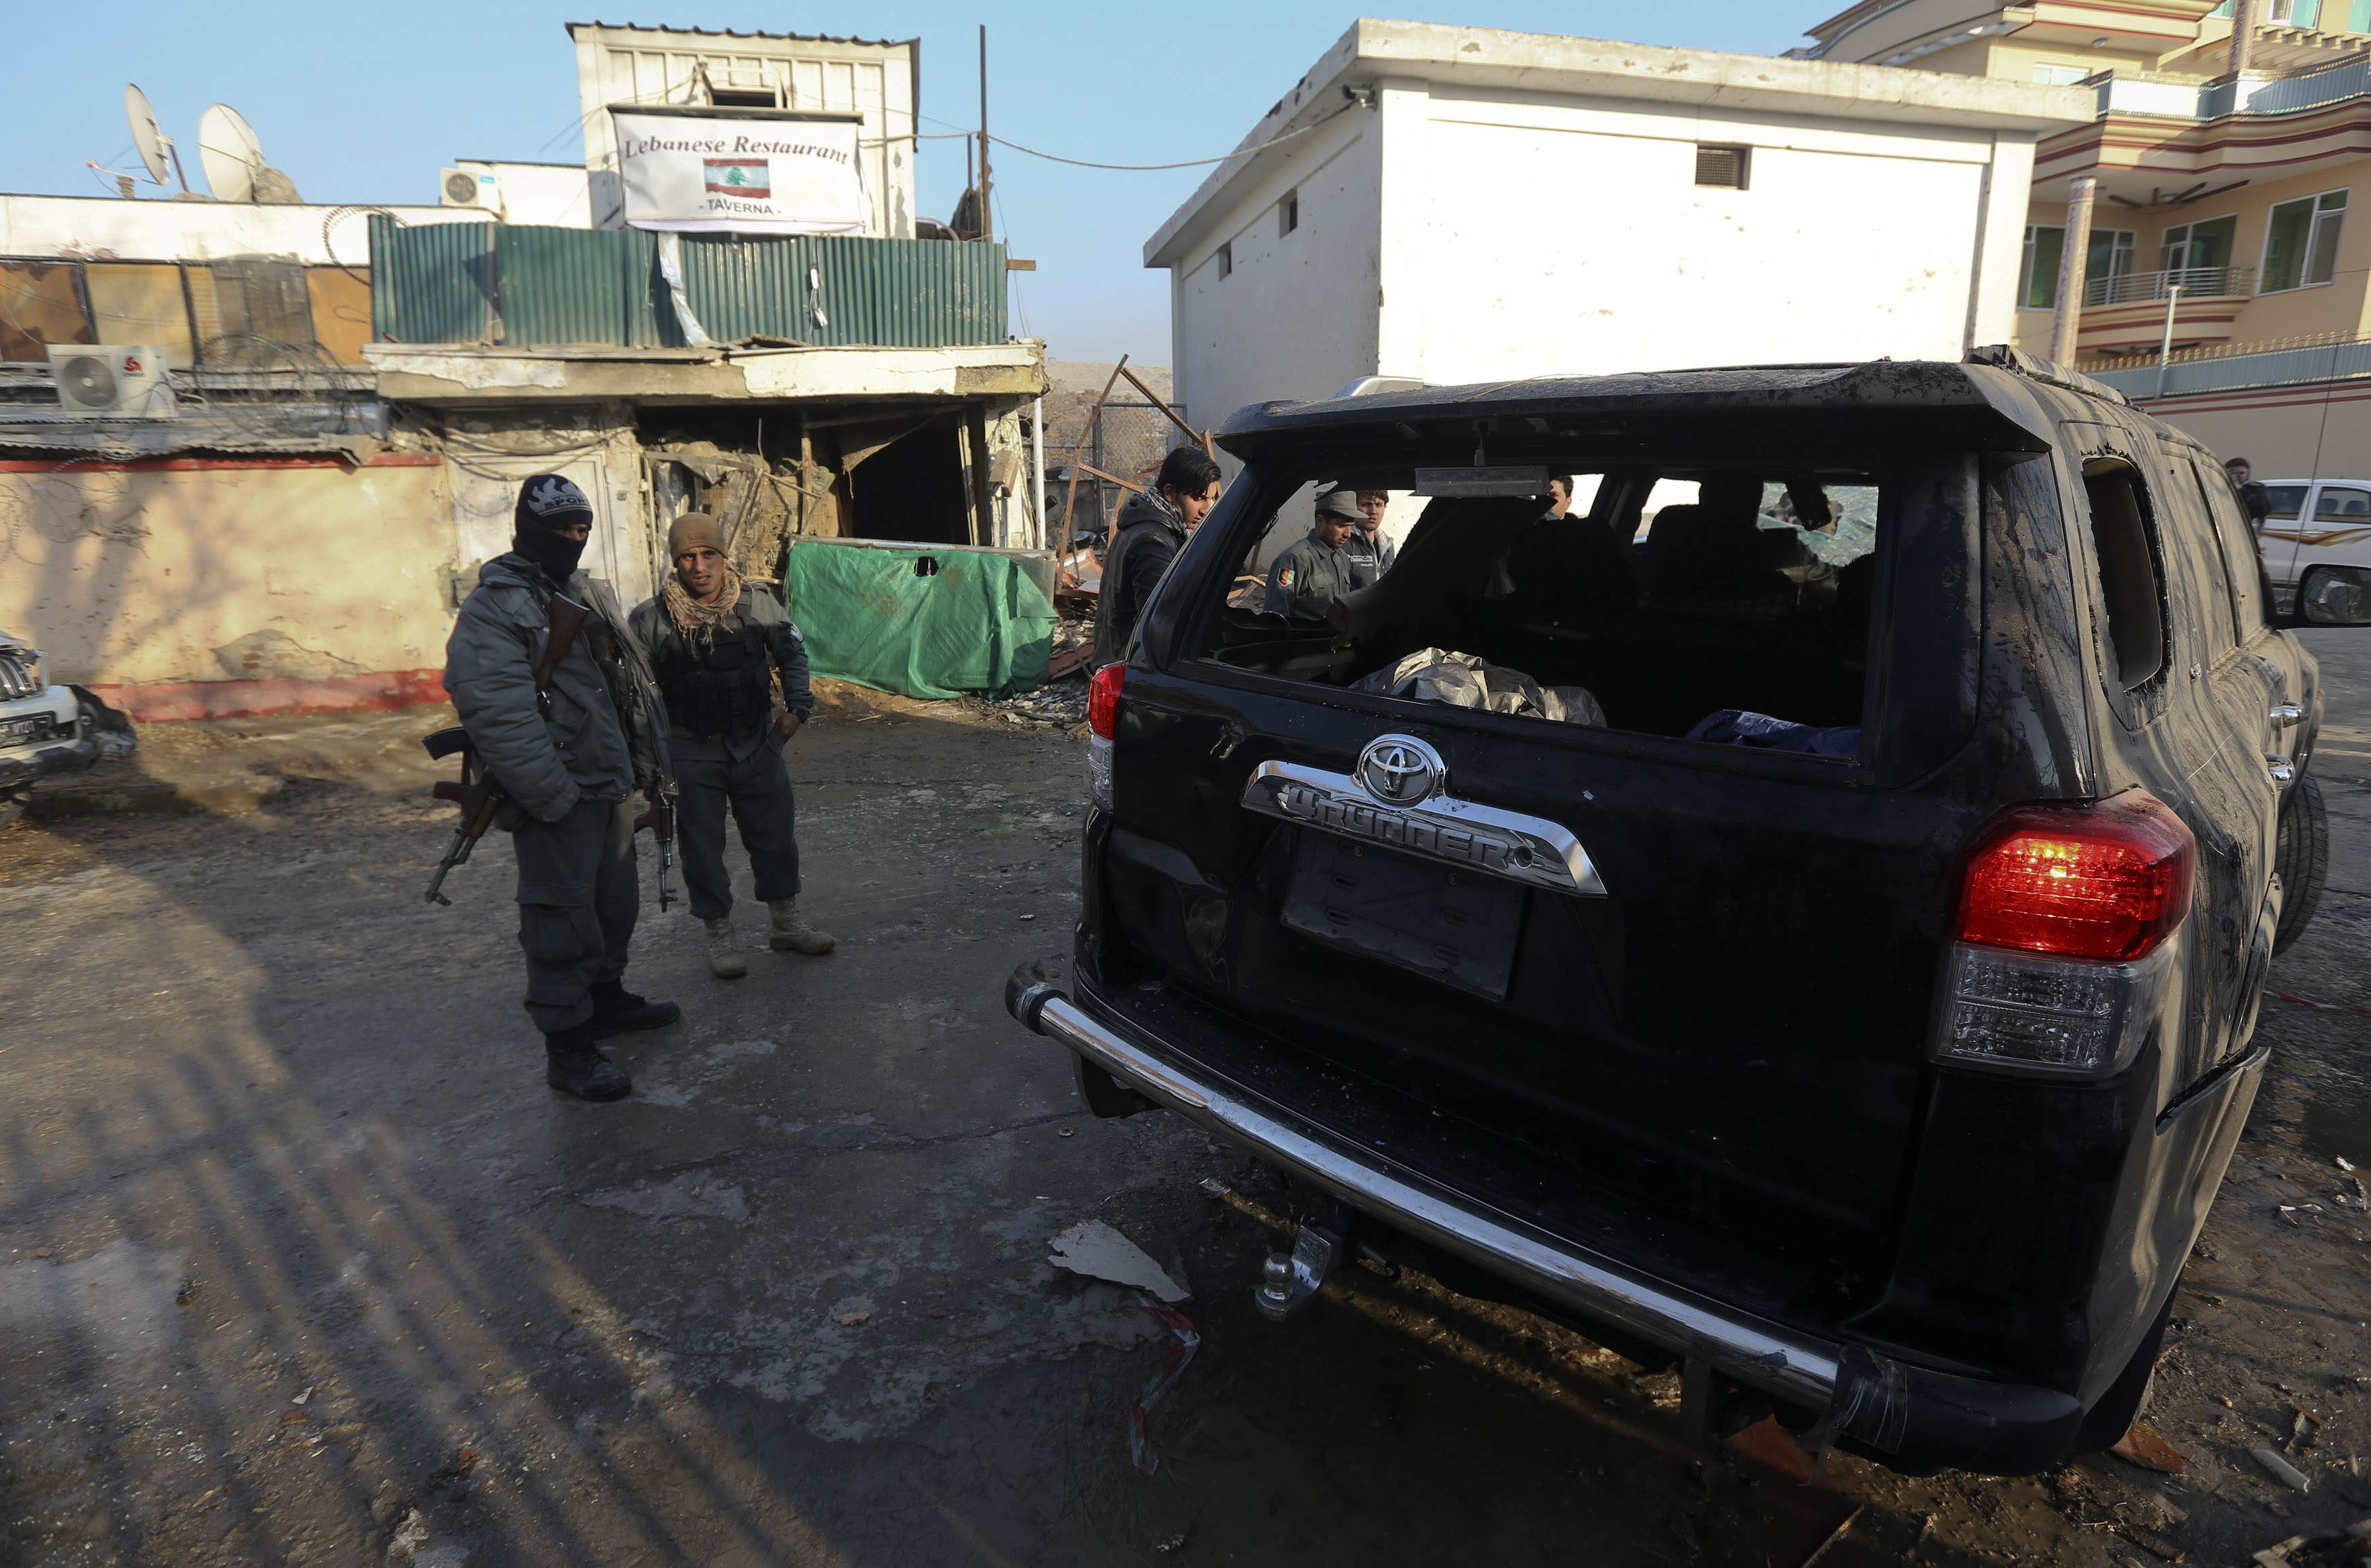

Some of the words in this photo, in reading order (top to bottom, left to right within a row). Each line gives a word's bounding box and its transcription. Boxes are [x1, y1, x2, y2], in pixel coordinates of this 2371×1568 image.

[624, 136, 725, 159] Lebanese
[734, 135, 849, 165] Restaurant
[707, 198, 773, 215] TAVERNA
